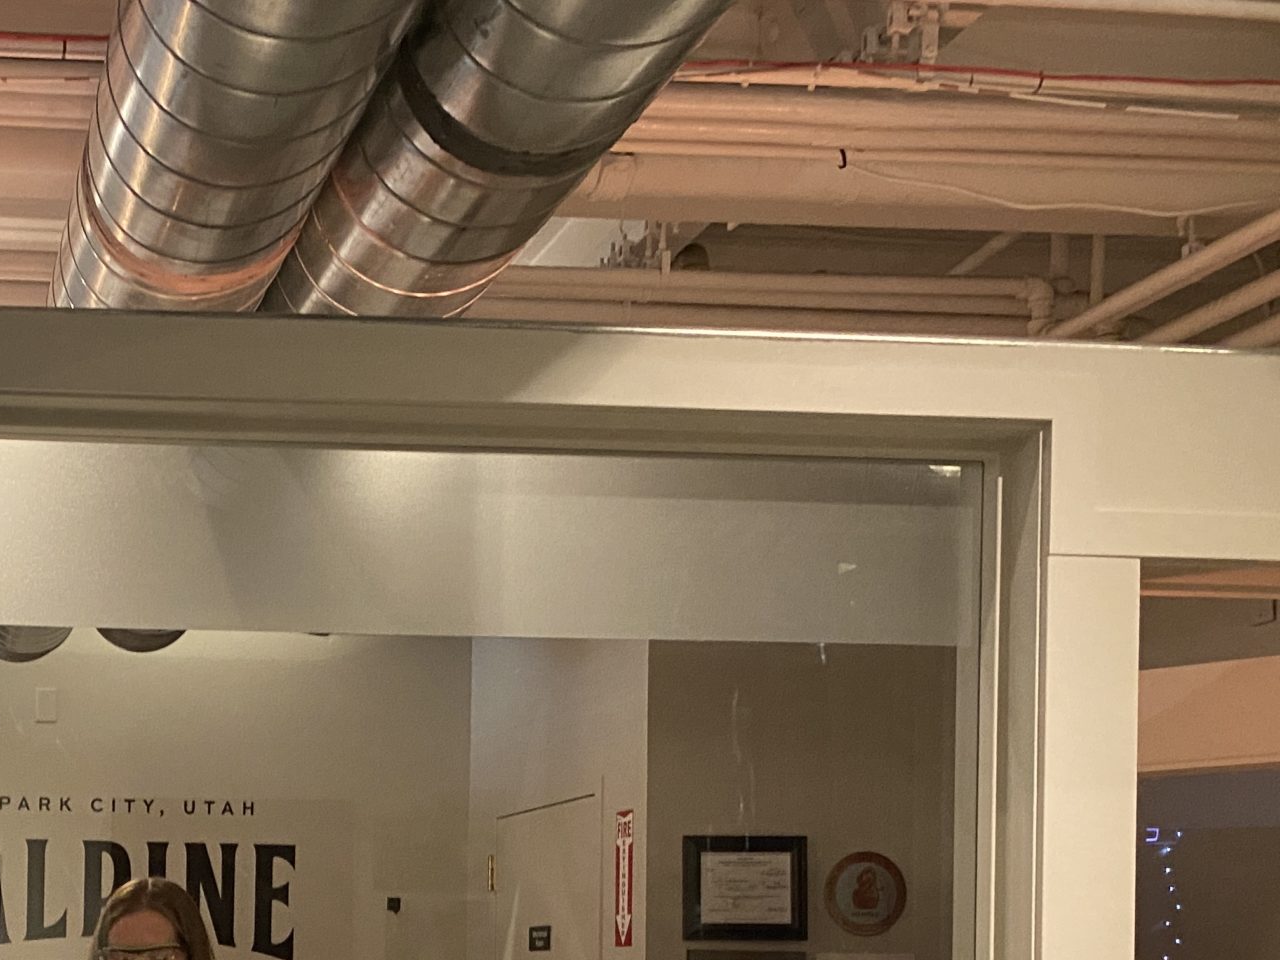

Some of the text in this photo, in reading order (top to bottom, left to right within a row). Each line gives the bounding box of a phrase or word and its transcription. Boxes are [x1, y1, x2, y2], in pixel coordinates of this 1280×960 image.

[90, 797, 166, 817] CITY,
[182, 800, 256, 817] UTAH
[617, 820, 632, 838] FIRE
